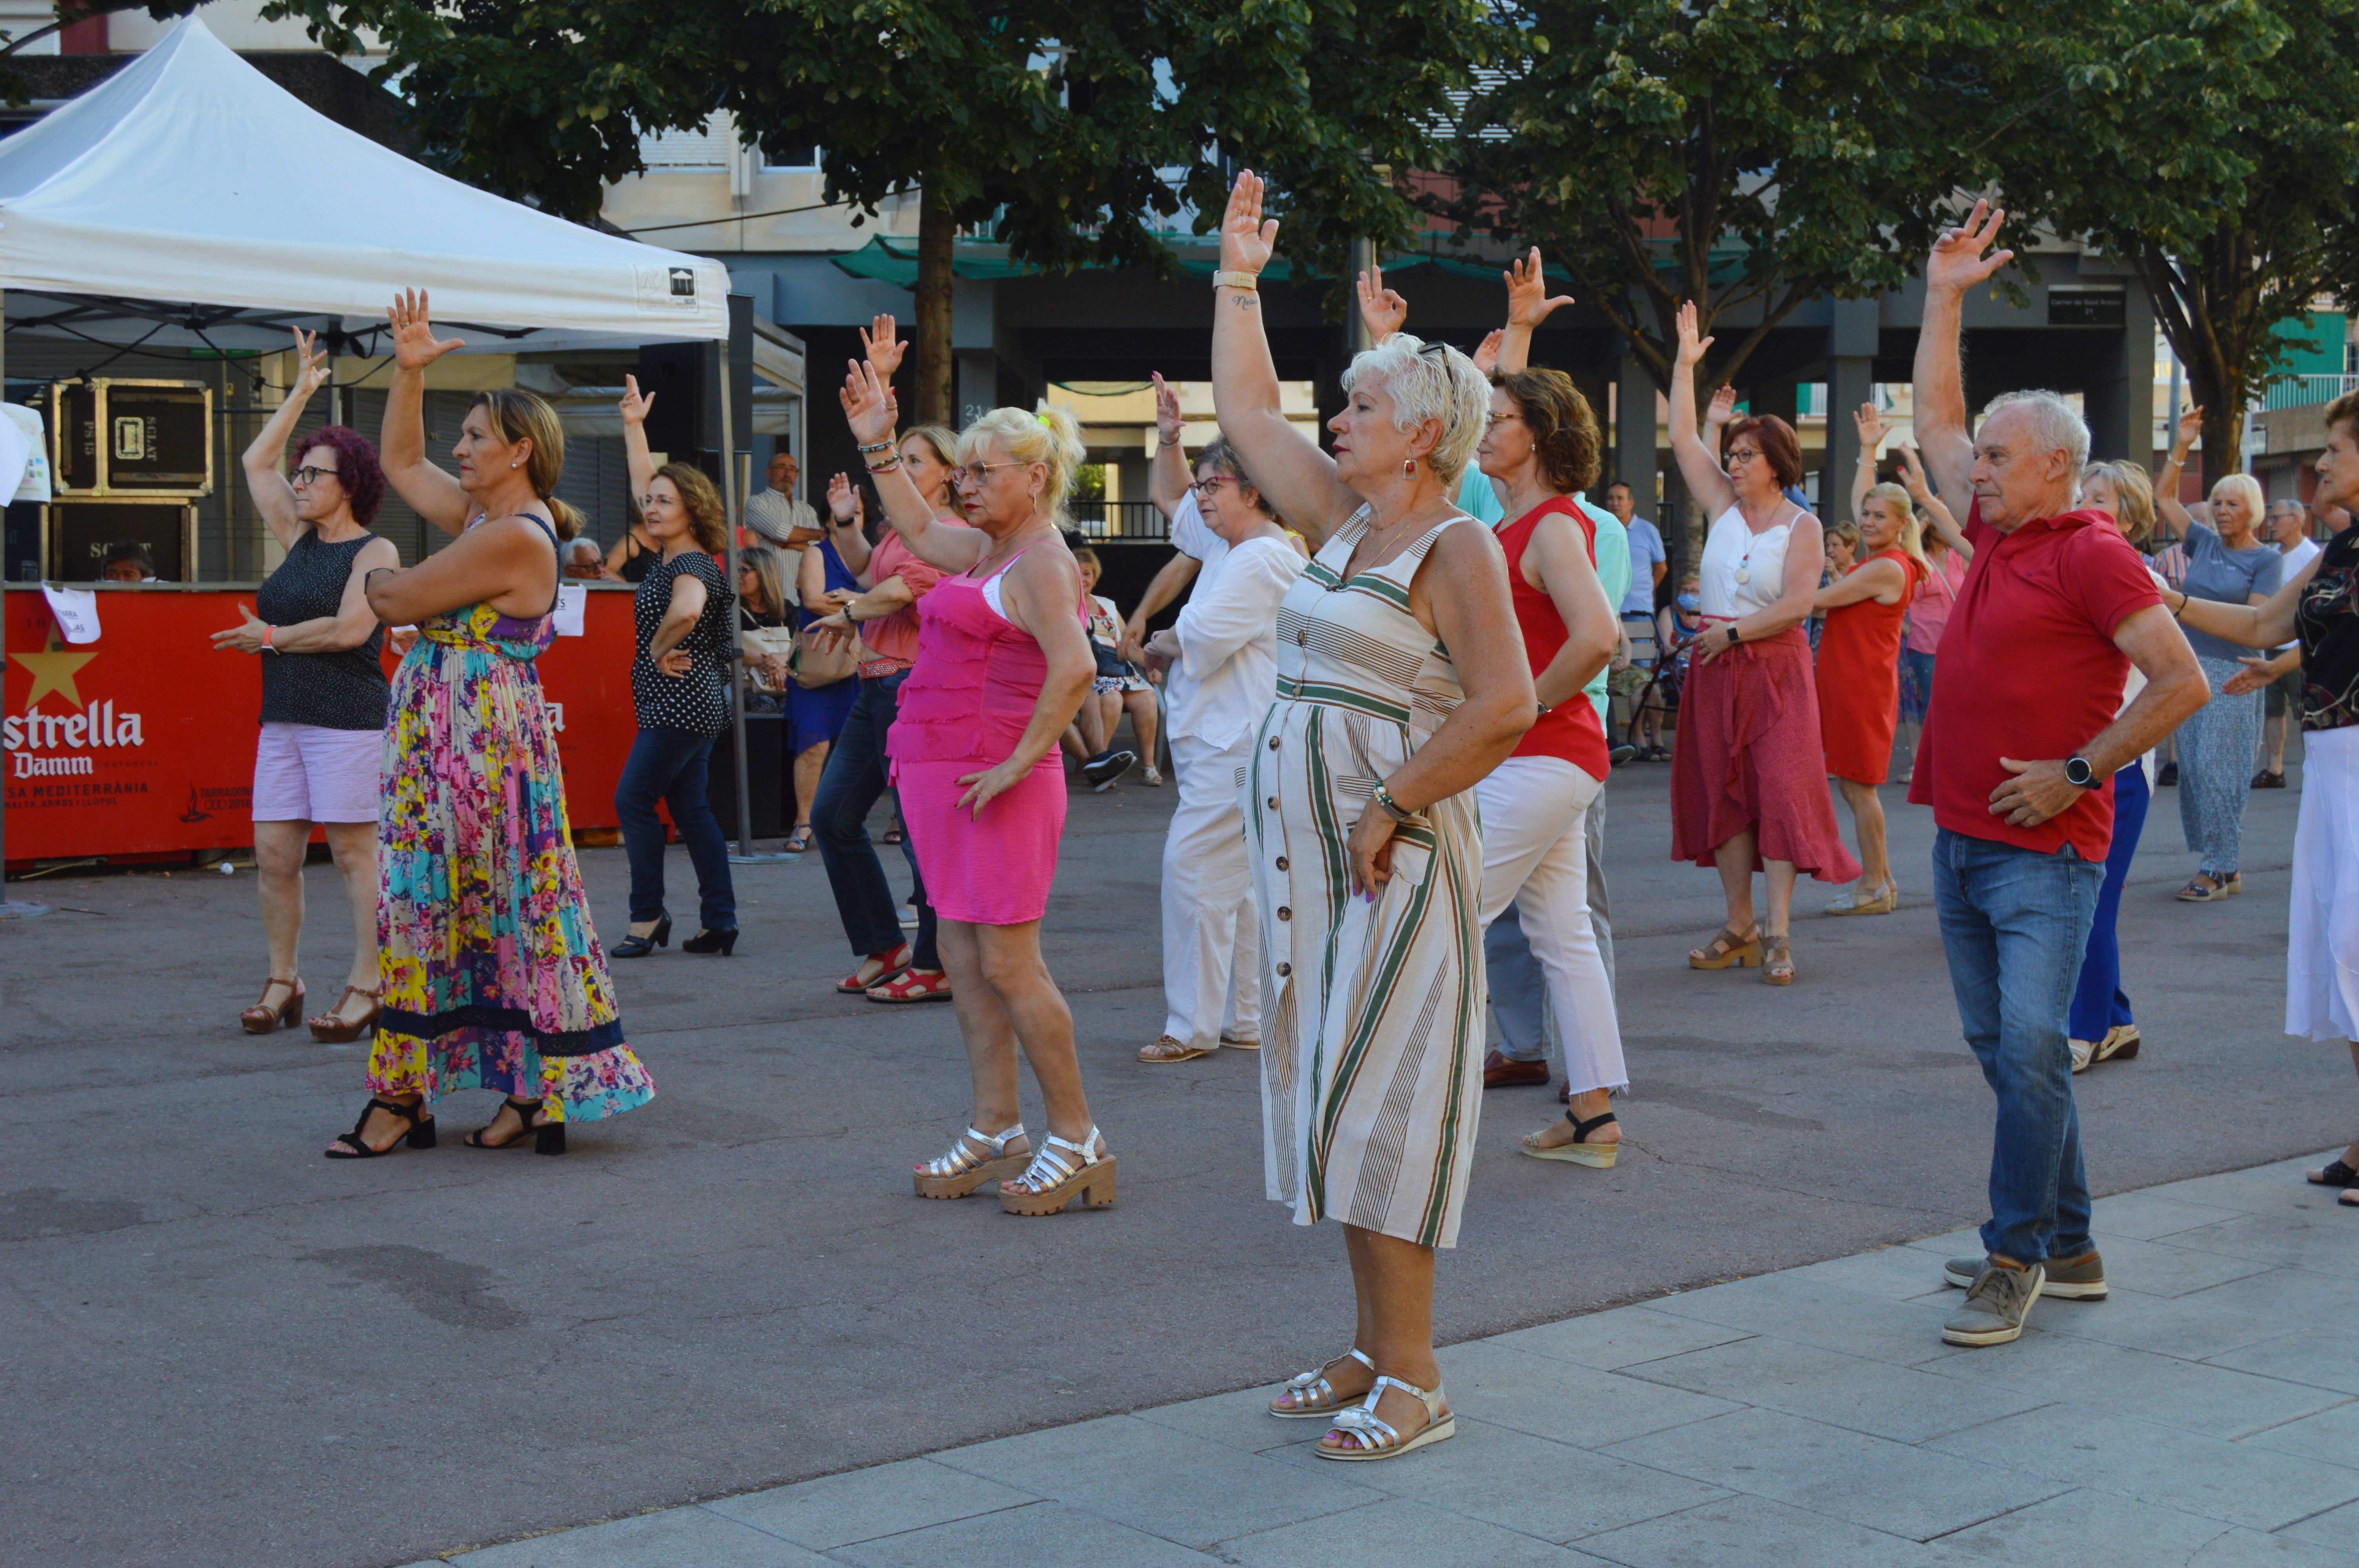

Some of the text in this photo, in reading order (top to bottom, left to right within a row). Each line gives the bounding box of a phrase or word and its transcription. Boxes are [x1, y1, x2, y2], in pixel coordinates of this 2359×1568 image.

[4, 699, 145, 751] strella
[13, 752, 94, 779] Damm
[33, 781, 149, 797] MEDITERRÀNIA
